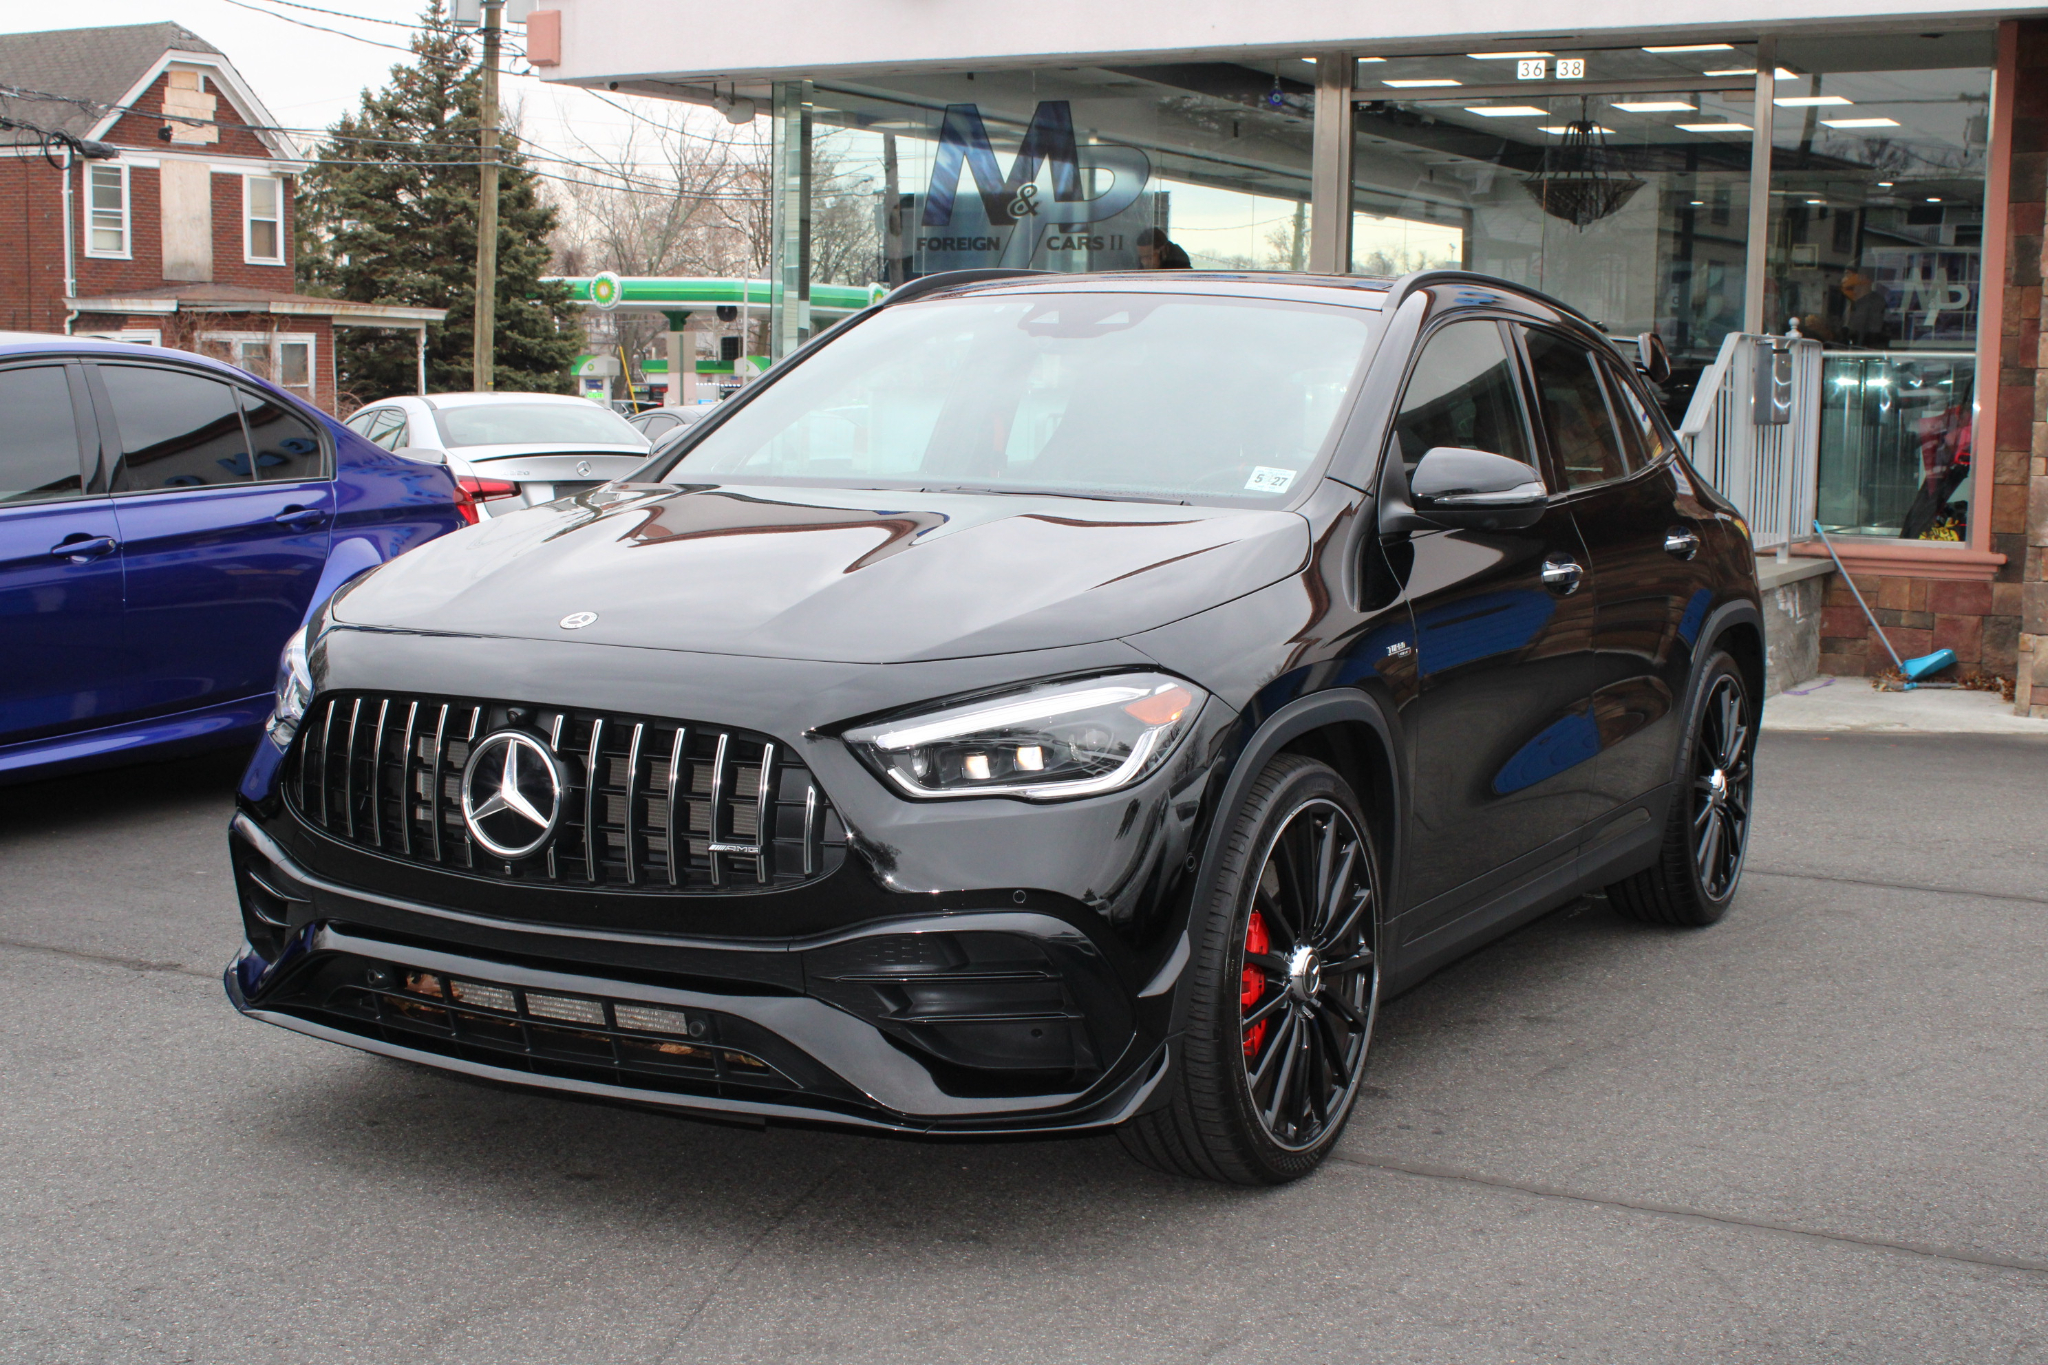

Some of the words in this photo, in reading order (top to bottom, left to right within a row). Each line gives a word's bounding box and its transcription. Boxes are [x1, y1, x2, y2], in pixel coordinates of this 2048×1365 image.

[916, 236, 1000, 251] FOREIGN
[1046, 236, 1104, 250] CARS
[1110, 234, 1123, 250] II
[1254, 473, 1265, 484] 5
[1270, 476, 1288, 487] 27
[724, 845, 759, 853] AMG
